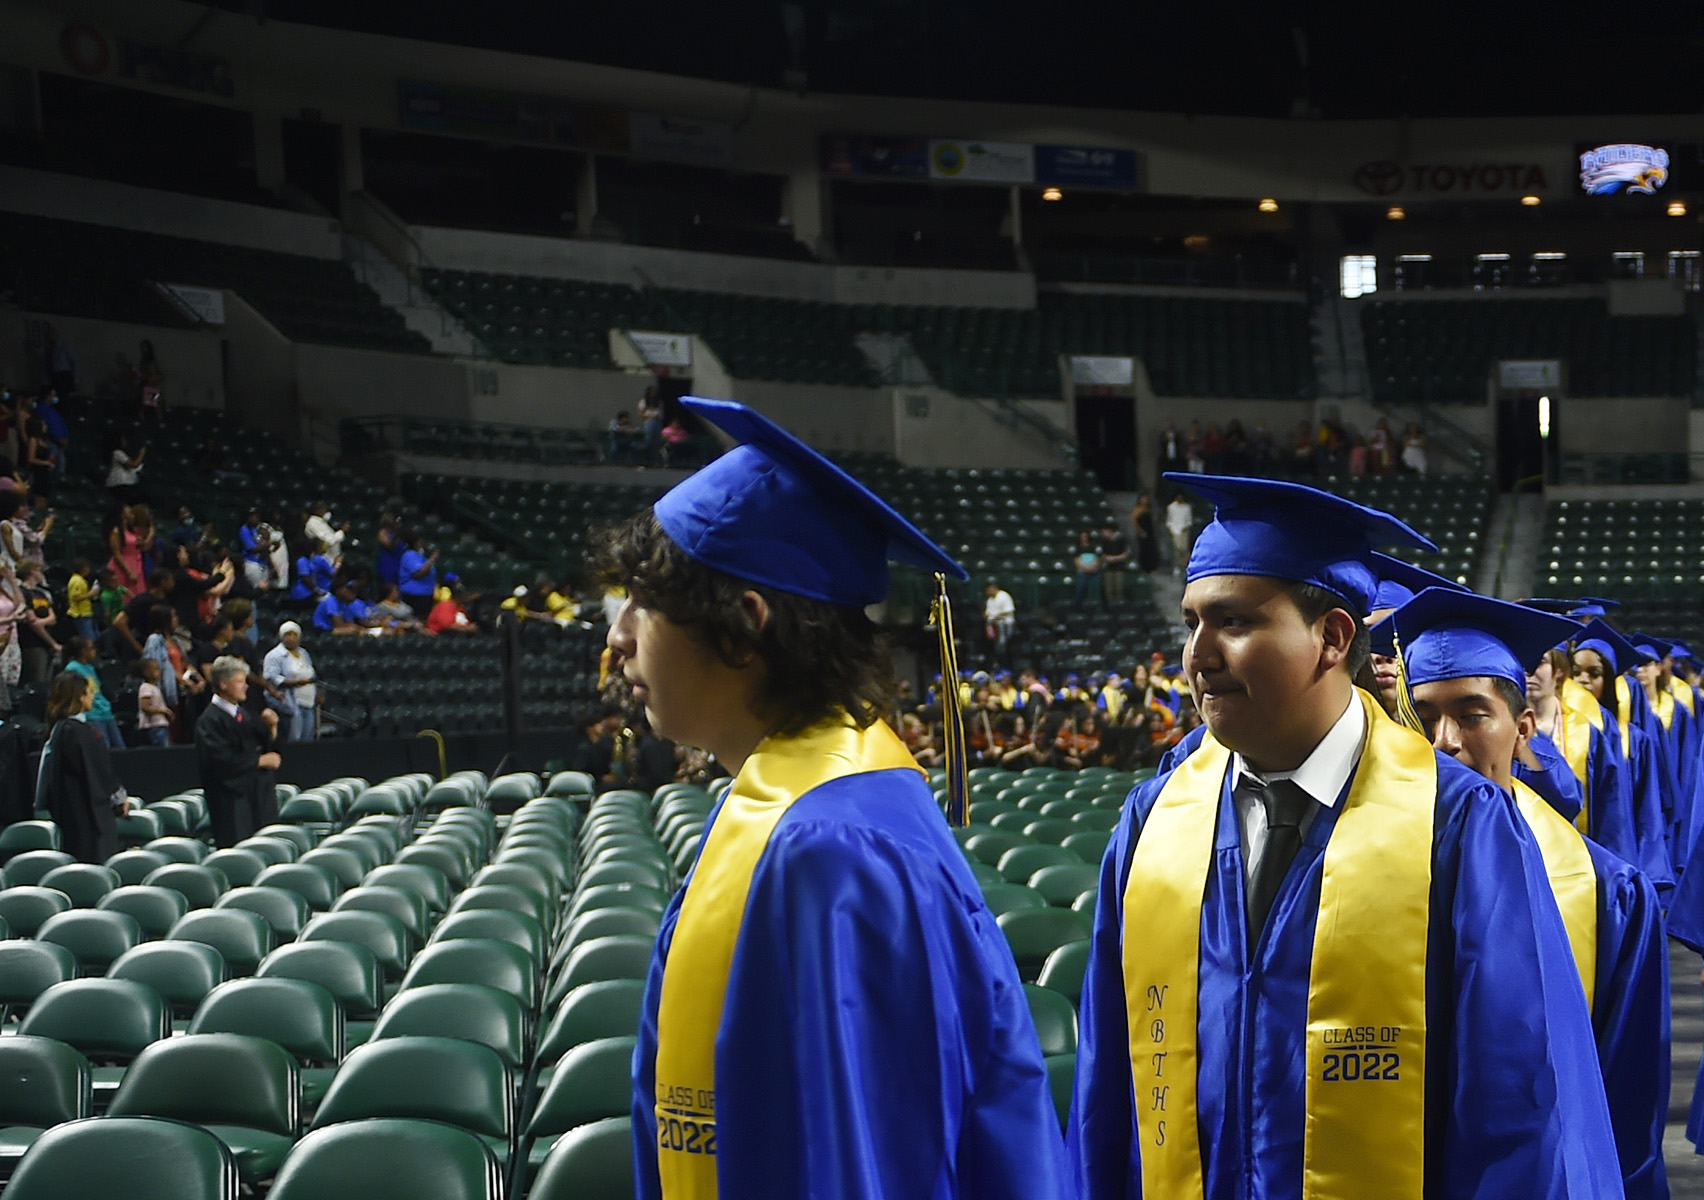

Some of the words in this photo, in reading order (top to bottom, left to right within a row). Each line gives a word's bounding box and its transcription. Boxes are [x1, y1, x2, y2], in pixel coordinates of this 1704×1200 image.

[1410, 164, 1547, 192] TOYOTA
[1323, 1027, 1375, 1044] CLASS
[1380, 1026, 1401, 1042] OF
[1147, 984, 1170, 1146] NBTHS
[1323, 1053, 1400, 1081] 2022
[659, 1117, 717, 1155] 2022
